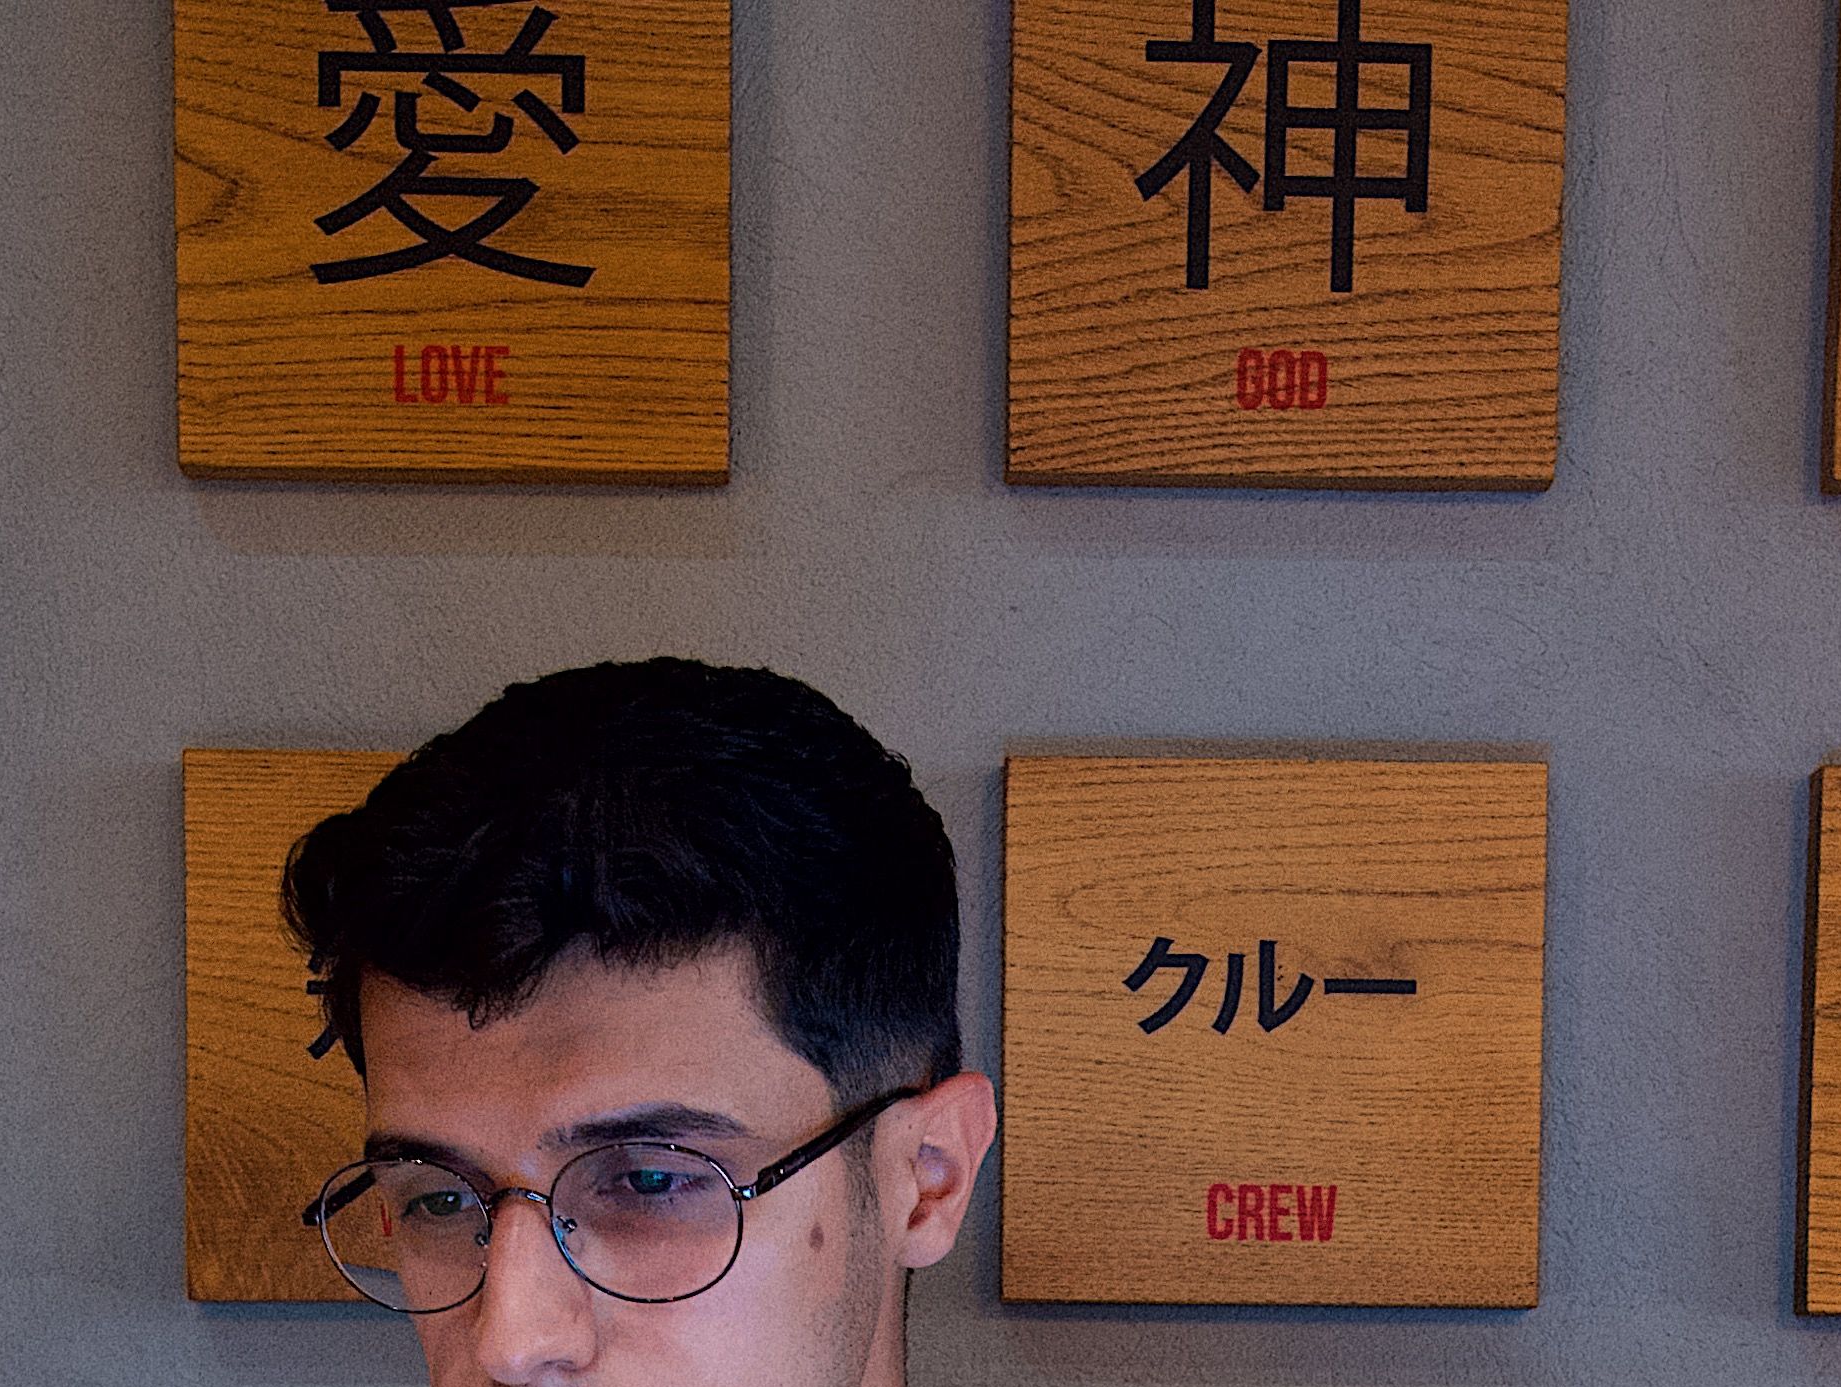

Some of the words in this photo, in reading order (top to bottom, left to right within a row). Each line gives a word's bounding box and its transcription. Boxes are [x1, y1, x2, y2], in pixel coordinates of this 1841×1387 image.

[310, 0, 596, 287] 愛
[1136, 0, 1432, 291] 神
[394, 346, 510, 405] LOVE
[1237, 349, 1328, 409] GOD
[1125, 938, 1416, 1033] クルー
[1207, 1183, 1336, 1241] CREW
